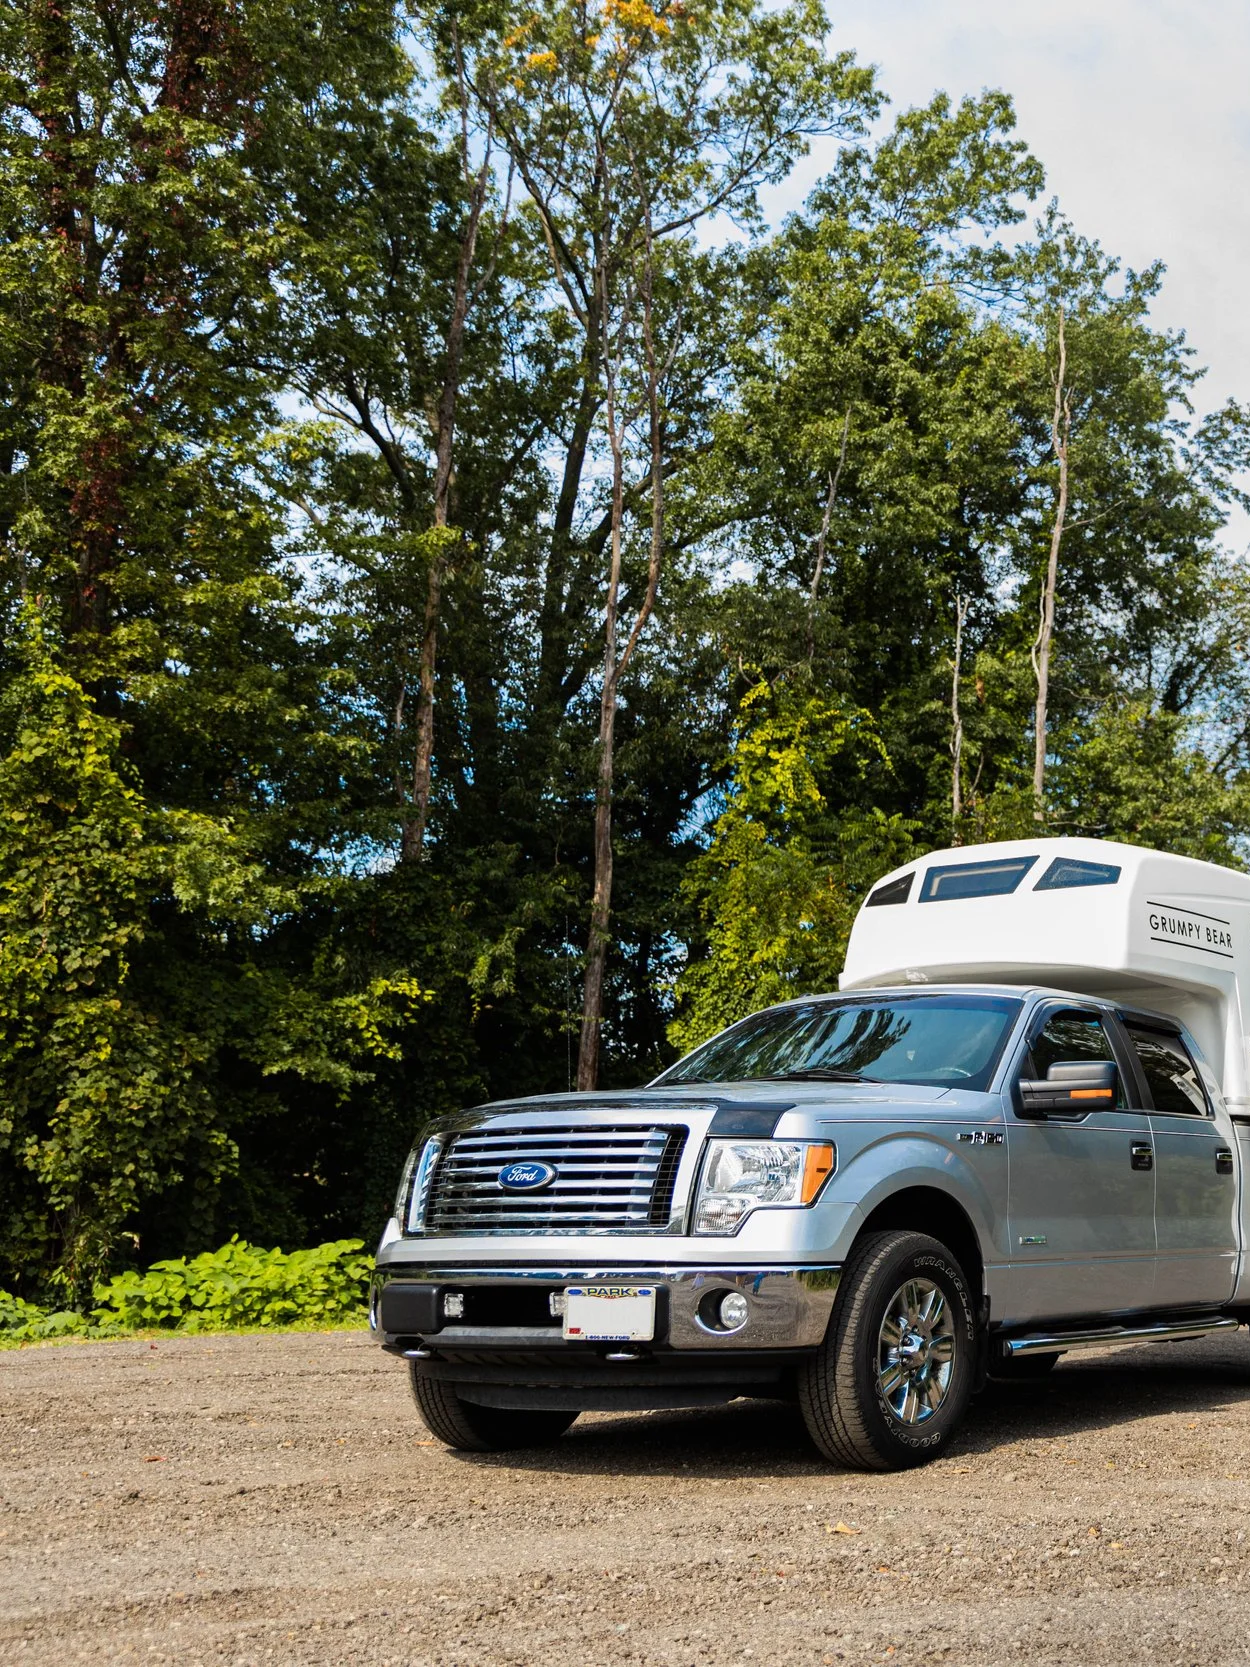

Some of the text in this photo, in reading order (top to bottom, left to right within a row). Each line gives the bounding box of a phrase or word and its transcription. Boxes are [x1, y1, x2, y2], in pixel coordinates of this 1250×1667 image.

[1149, 914, 1233, 948] GRUMPY BEAR
[507, 1166, 539, 1182] Ford
[587, 1288, 632, 1296] PARK
